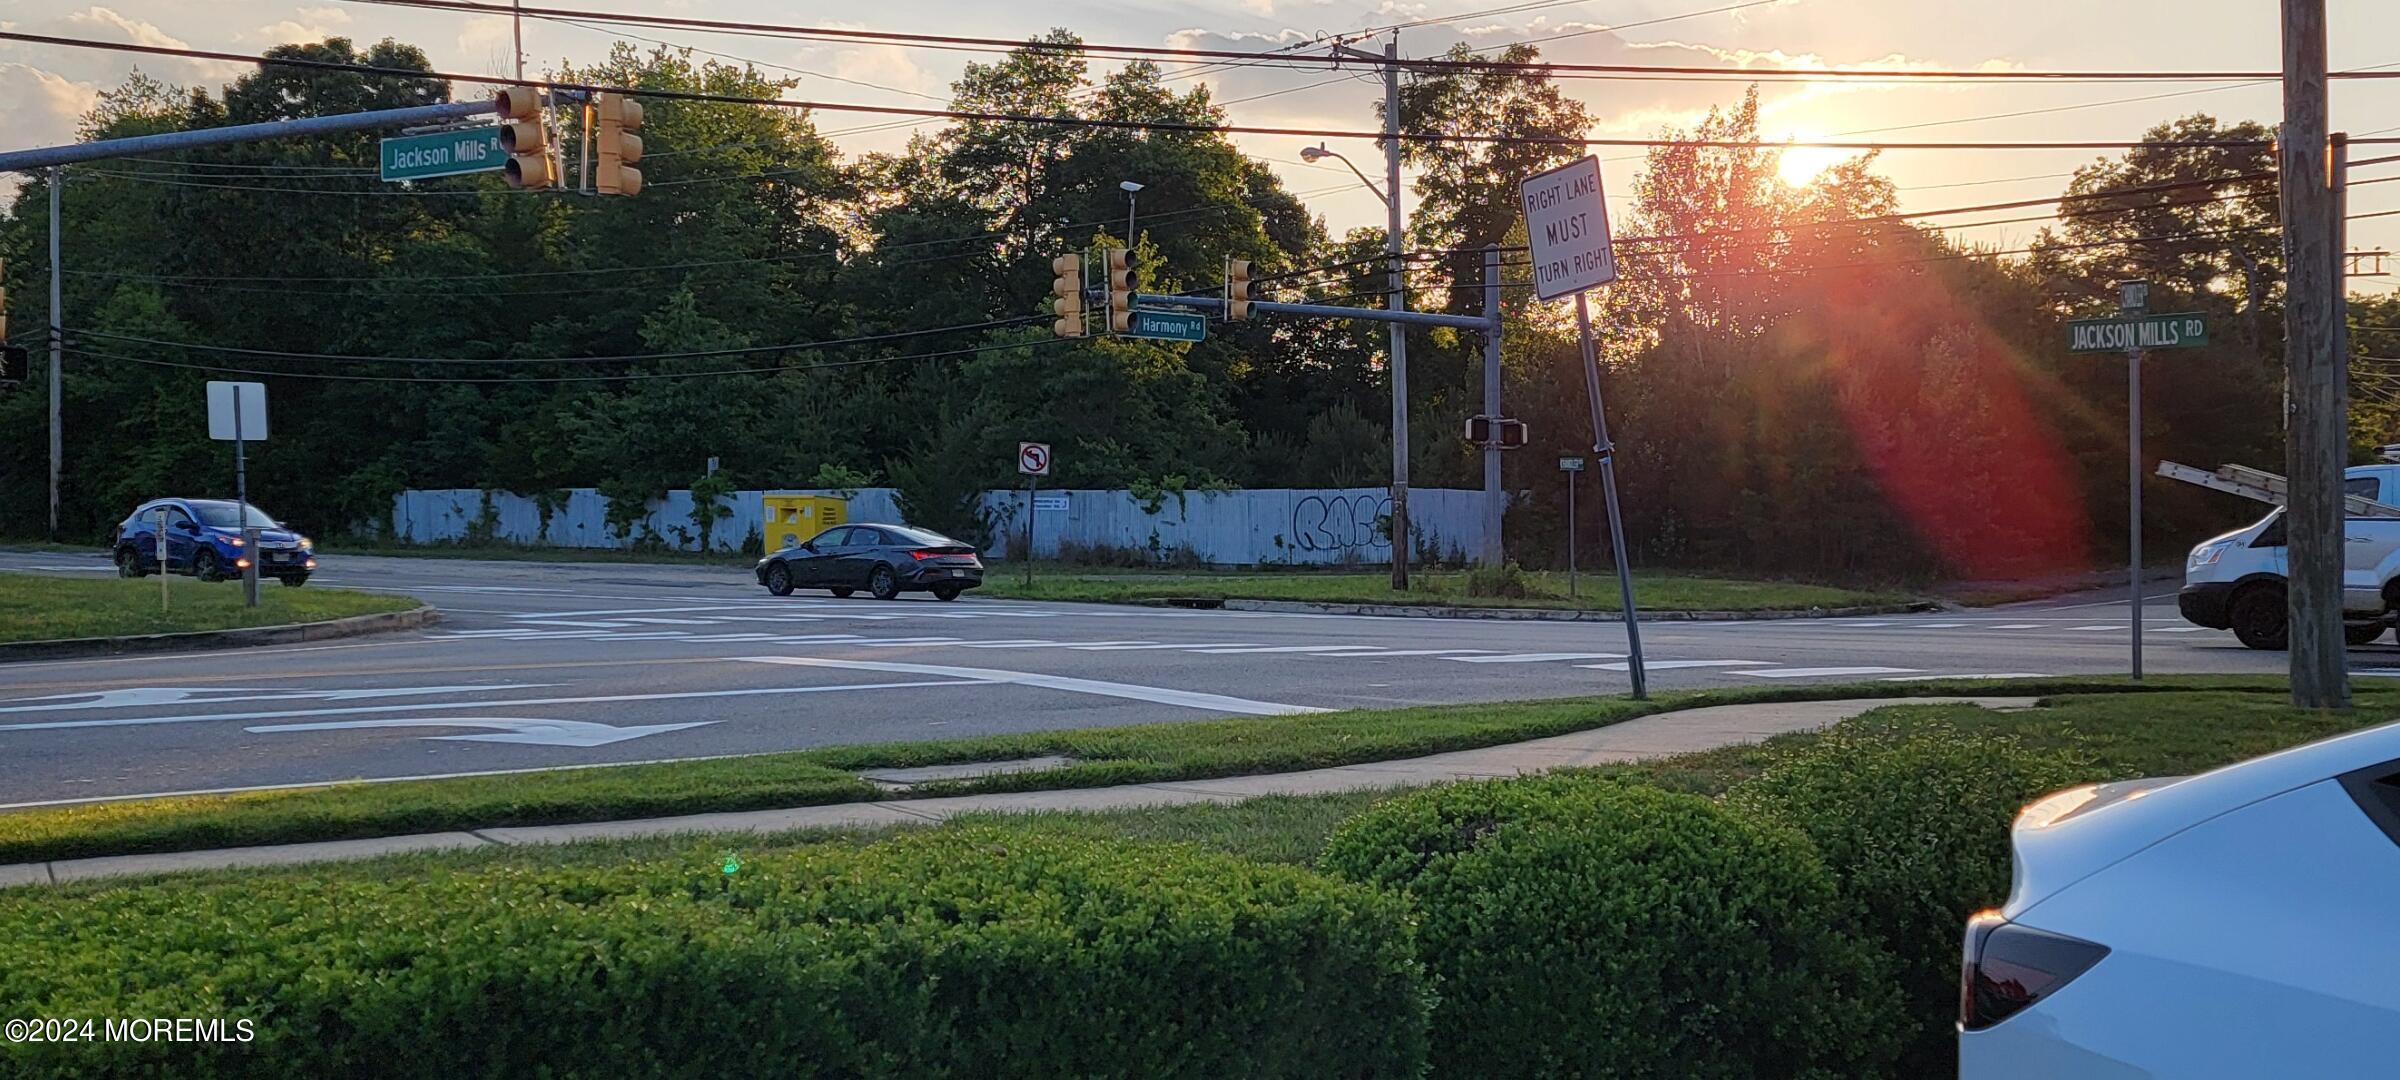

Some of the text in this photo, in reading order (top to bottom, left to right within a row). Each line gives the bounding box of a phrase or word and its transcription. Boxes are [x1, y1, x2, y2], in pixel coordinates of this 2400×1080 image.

[389, 146, 449, 170] Jackson
[454, 140, 486, 163] Mills
[1527, 174, 1597, 213] RIGHT LANE
[1545, 213, 1588, 247] MUST
[1538, 247, 1608, 284] TURN RIGHT
[1142, 317, 1201, 337] Harmony Rd
[2072, 319, 2203, 350] JACKSON MILLS RD
